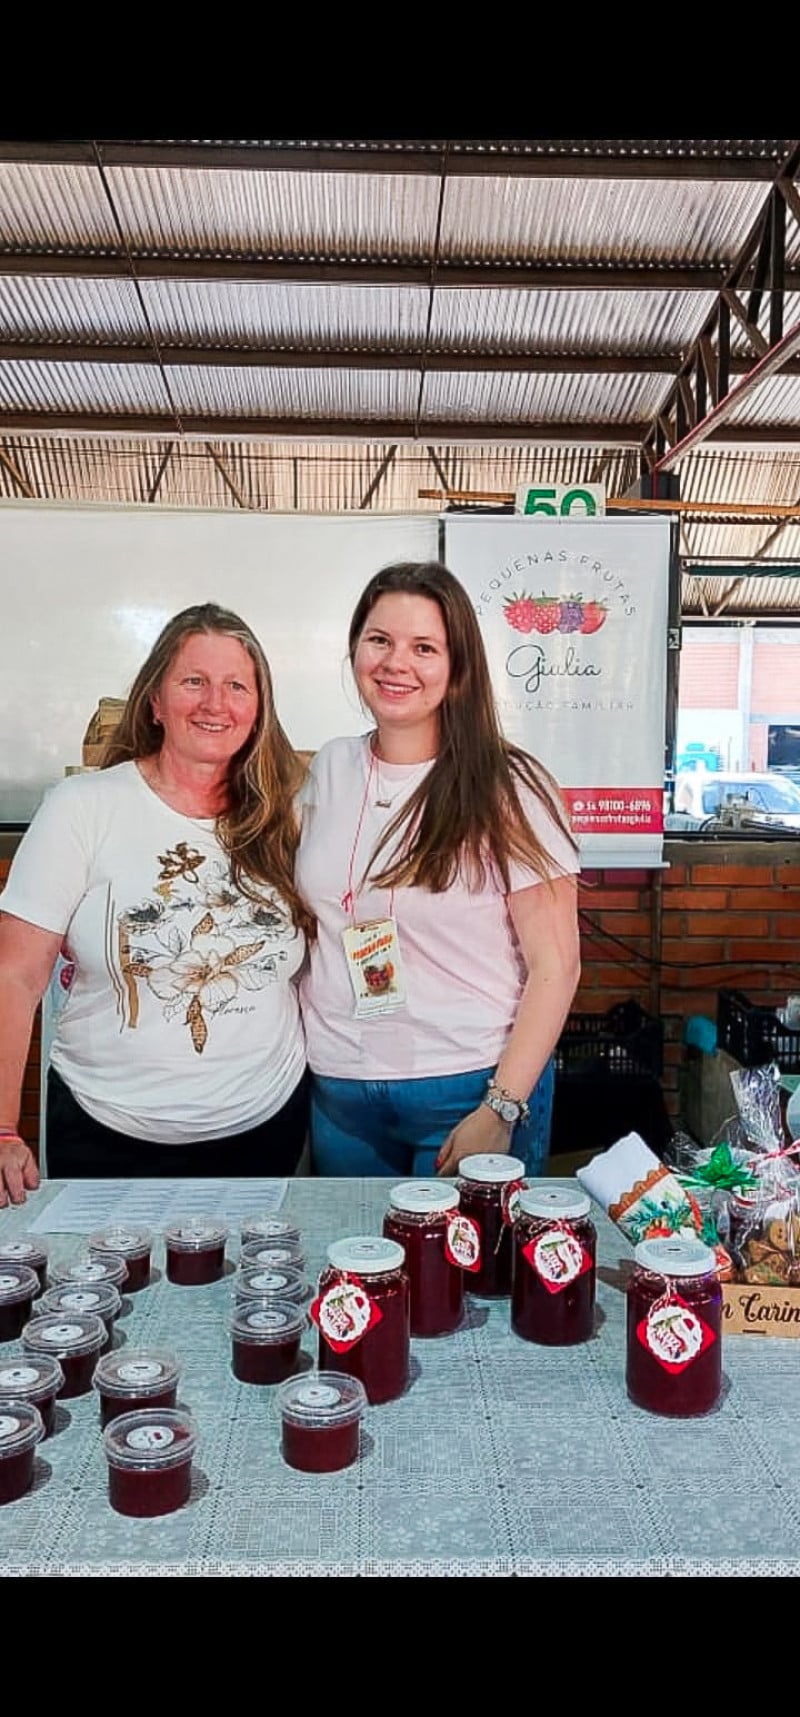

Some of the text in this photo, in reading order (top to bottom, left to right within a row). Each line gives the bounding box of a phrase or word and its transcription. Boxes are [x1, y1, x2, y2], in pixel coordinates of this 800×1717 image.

[524, 489, 596, 516] 50
[477, 550, 636, 616] PEQUENAS FRUTAS
[506, 643, 601, 693] Giulia
